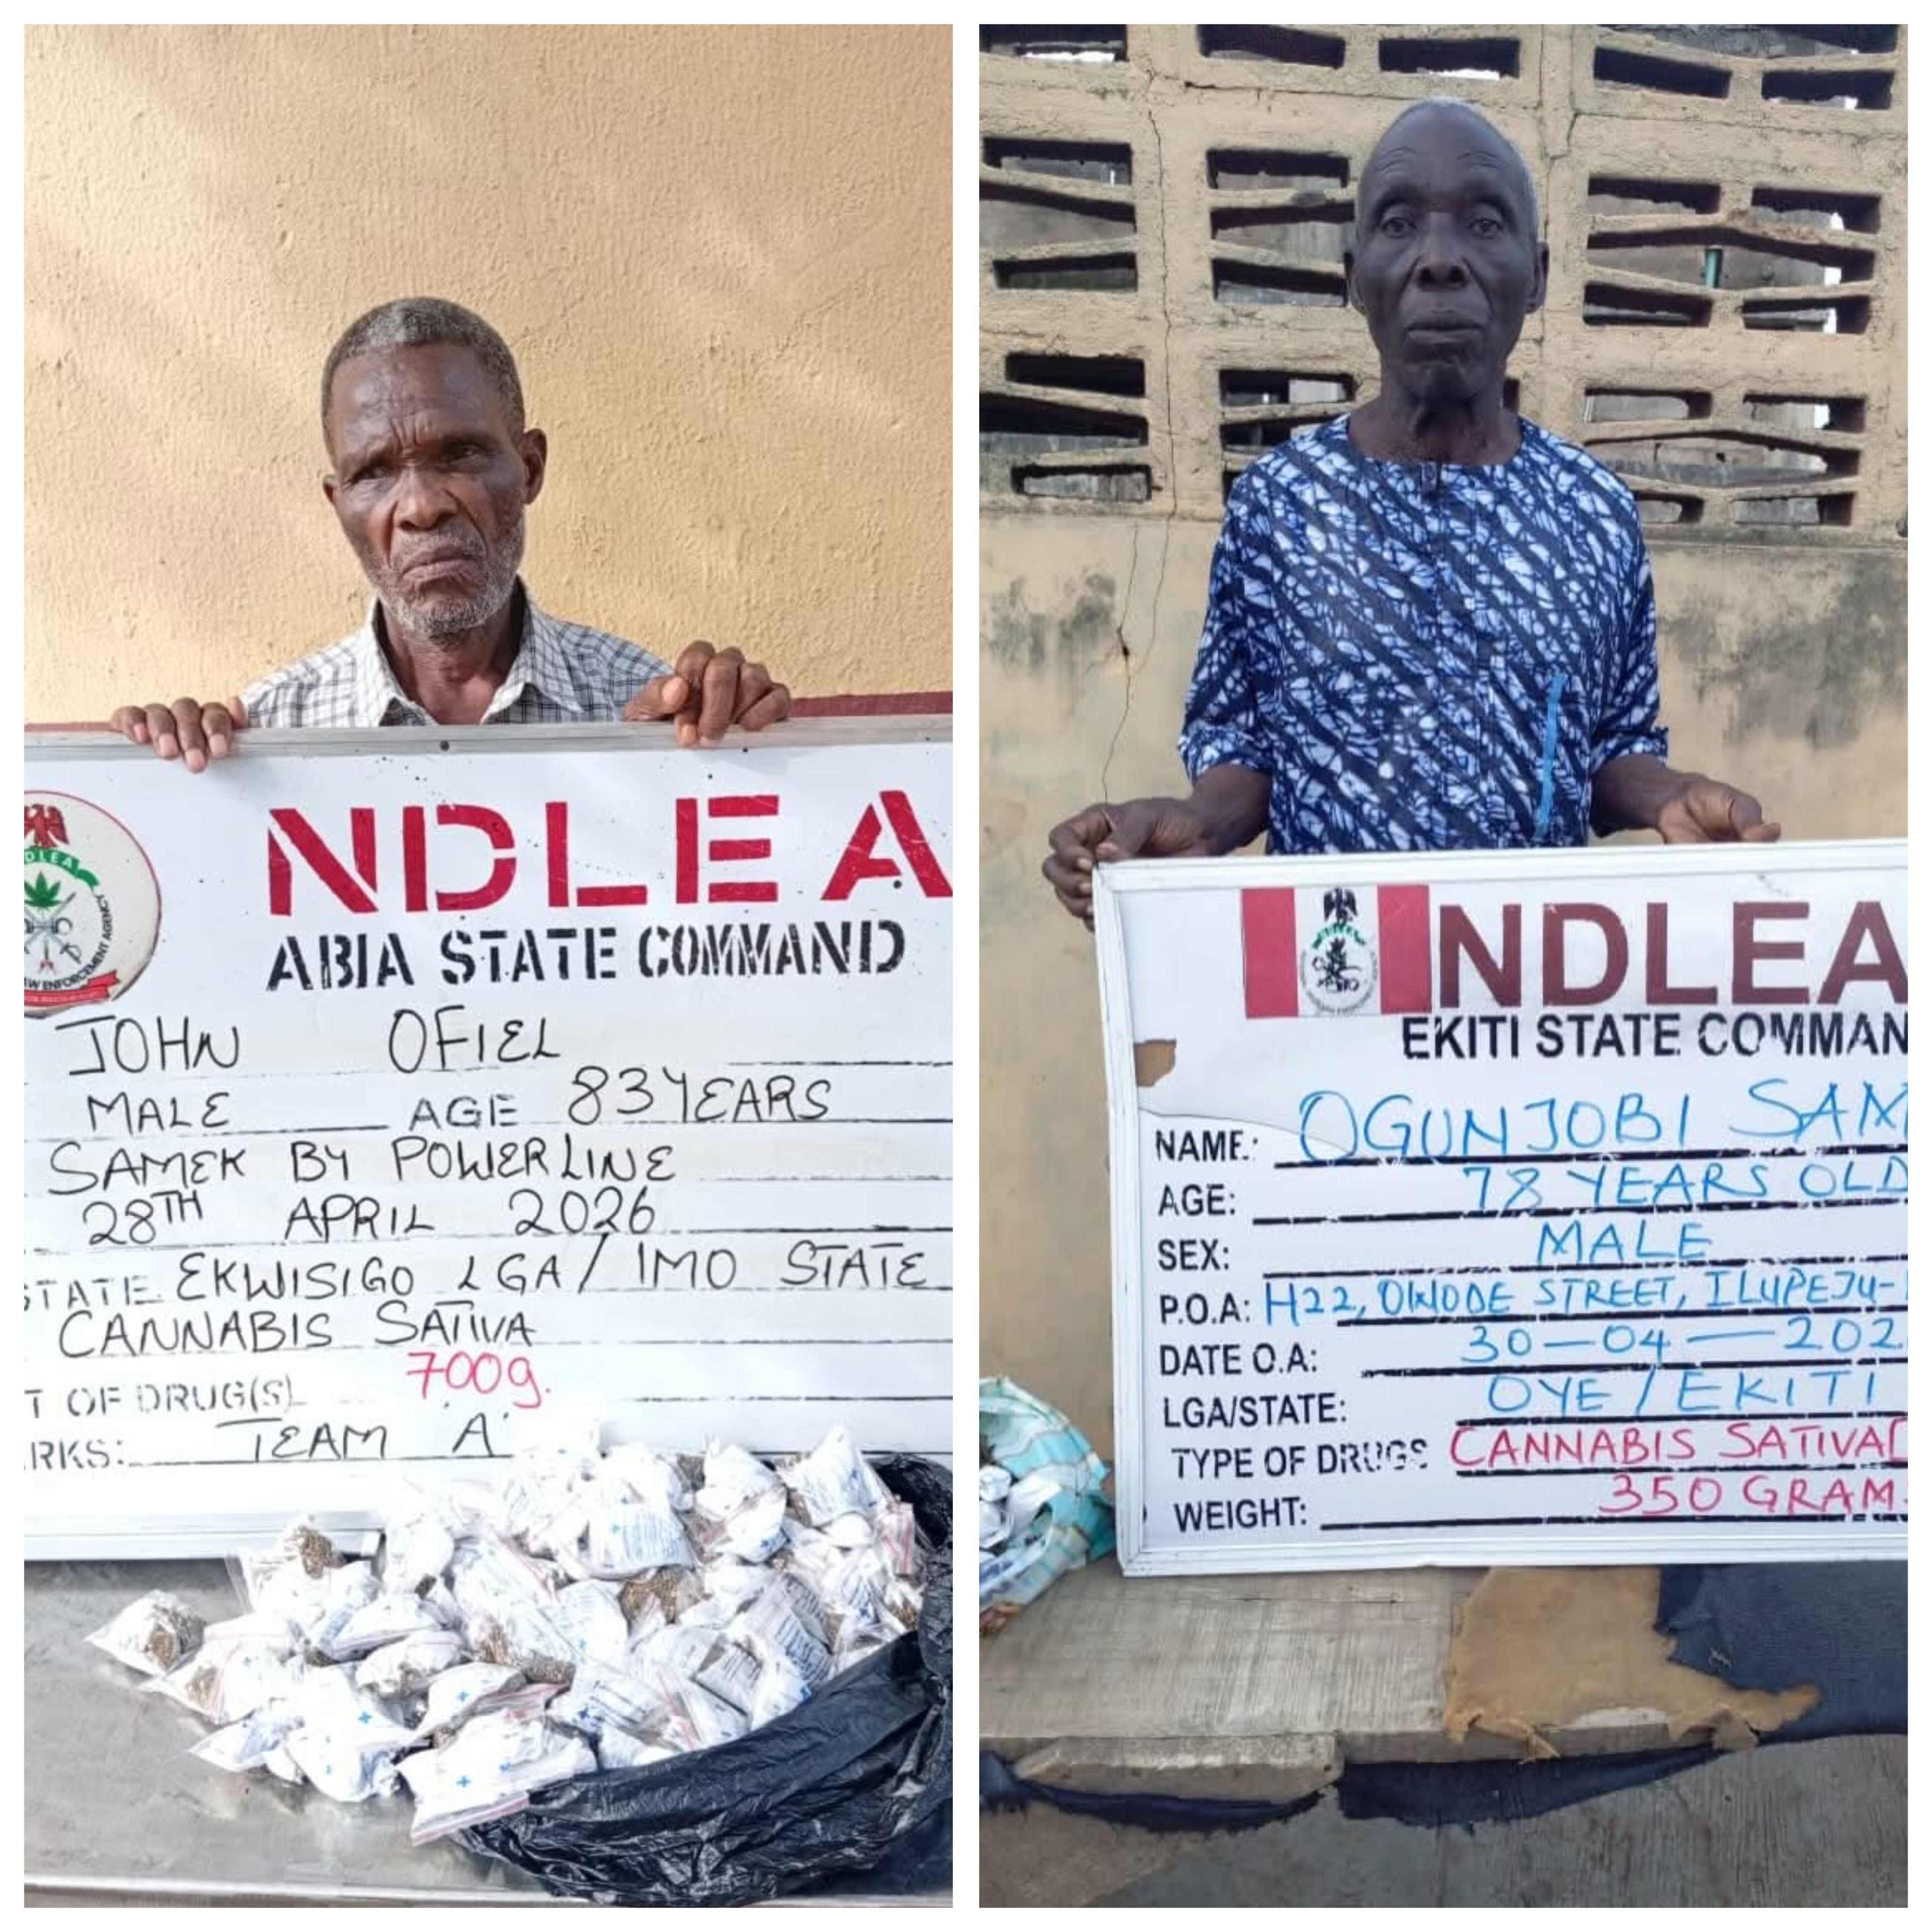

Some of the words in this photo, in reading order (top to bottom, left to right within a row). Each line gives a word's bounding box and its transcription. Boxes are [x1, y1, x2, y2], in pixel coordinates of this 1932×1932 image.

[267, 791, 953, 916] NDLEA
[266, 932, 414, 991] ABIA
[440, 927, 616, 985] STATE
[639, 920, 905, 978] COMMAND
[1440, 901, 1907, 1008] NDLEA
[56, 1016, 239, 1075] JOHN
[389, 1005, 560, 1073] OFIEL
[1403, 1014, 1518, 1059] EKITI
[1536, 1012, 1681, 1058] STATE
[1699, 1011, 1907, 1058] COMMAN
[87, 1091, 230, 1131] MALE
[409, 1093, 516, 1130] AGE
[48, 1141, 245, 1194] SAMEK
[291, 1141, 348, 1182] BY
[1156, 1129, 1258, 1162] NAME:
[1158, 1184, 1235, 1216] AGE:
[1462, 1167, 1542, 1213] 78
[1568, 1162, 1767, 1207] YEARS
[1799, 1156, 1907, 1197] OLD
[82, 1190, 202, 1245] 28TH
[285, 1194, 434, 1243] APRIL
[510, 1187, 655, 1235] 2026
[176, 1252, 413, 1300] EKWISIGO
[639, 1242, 736, 1289] IMO
[781, 1240, 926, 1287] STATE
[1158, 1239, 1229, 1271] SEX:
[1538, 1220, 1712, 1264] MALE
[1160, 1293, 1250, 1324] P.O.A:
[1705, 1267, 1907, 1306] ILUPEJU-
[59, 1310, 332, 1358] CANNABIS
[375, 1299, 536, 1346] SATIVA
[1160, 1345, 1241, 1376] DATE
[67, 1386, 121, 1416] OF
[1164, 1393, 1346, 1428] LGA/STATE:
[24, 1440, 125, 1471] RKS:
[216, 1418, 387, 1462] TEAM
[1172, 1448, 1252, 1479] TYPE
[1264, 1446, 1306, 1477] OF
[1318, 1439, 1428, 1474] DRUGS
[1450, 1427, 1695, 1468] CANNABIS
[1174, 1496, 1307, 1532] WEIGHT:
[1599, 1474, 1722, 1517] 350
